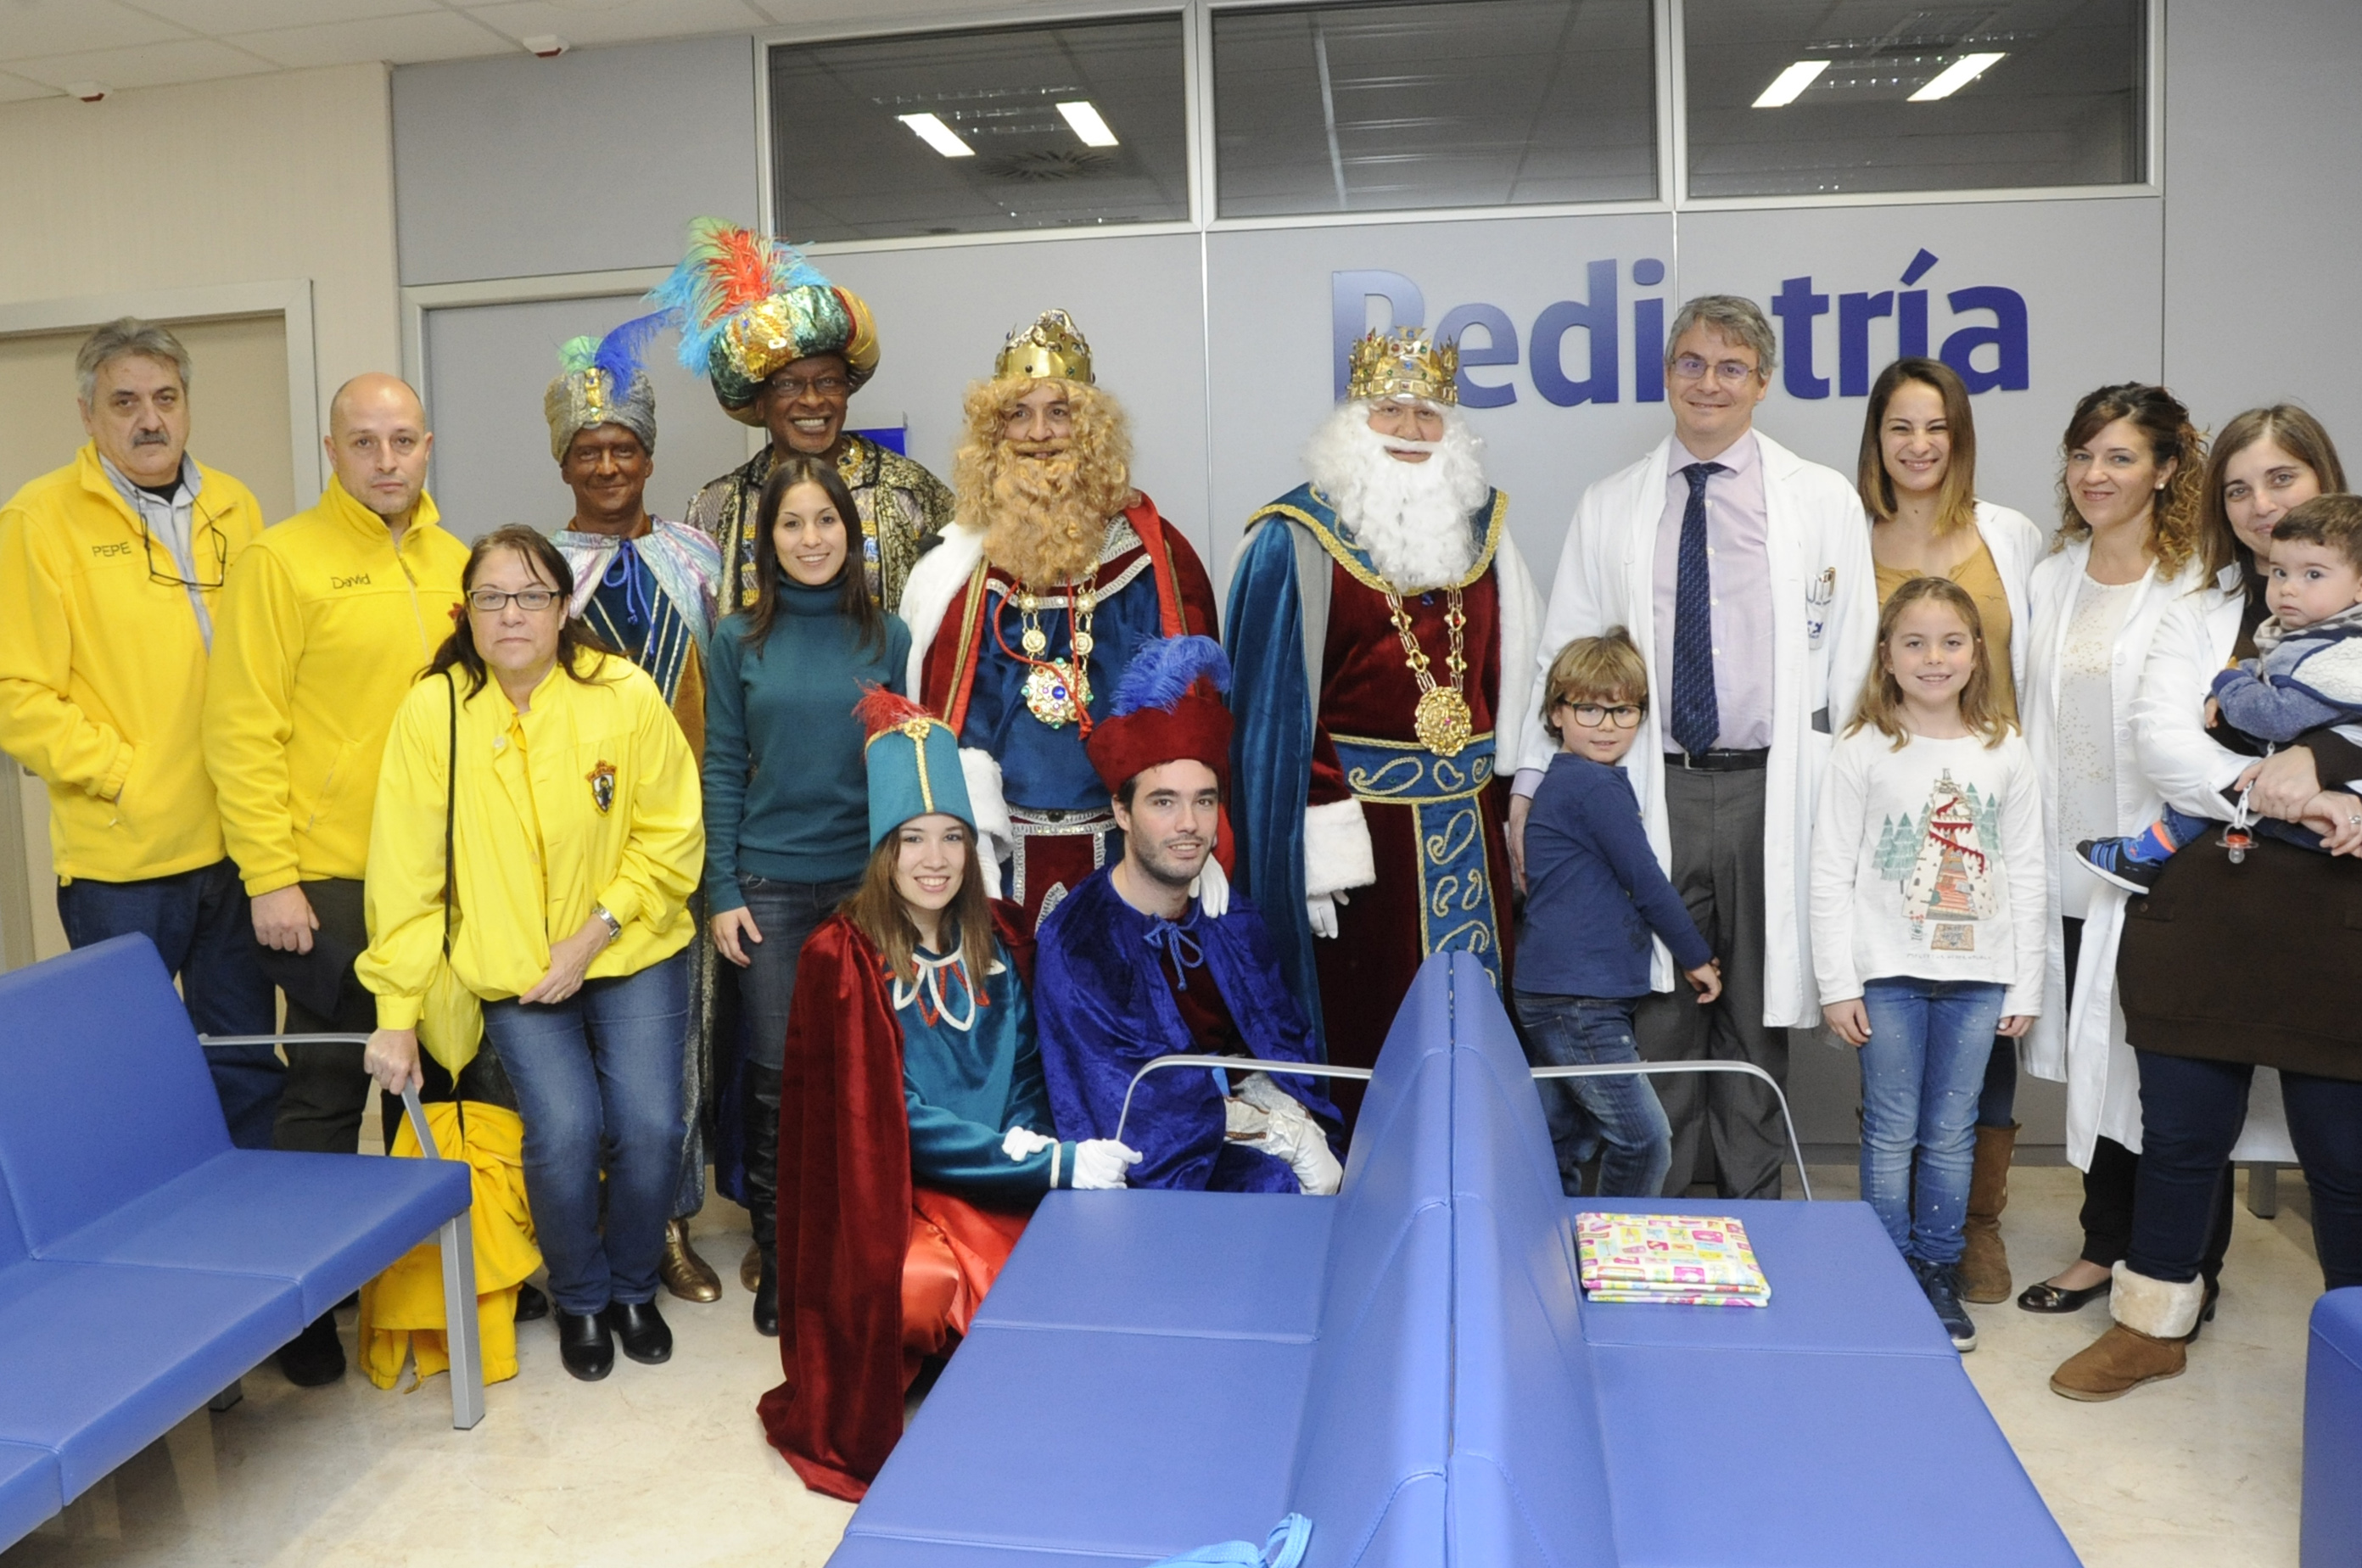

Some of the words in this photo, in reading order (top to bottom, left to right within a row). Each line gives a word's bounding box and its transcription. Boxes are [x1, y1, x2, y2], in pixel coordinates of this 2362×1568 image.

[1331, 248, 2029, 409] Peditría
[92, 541, 132, 557] PEPE
[331, 573, 371, 590] David
